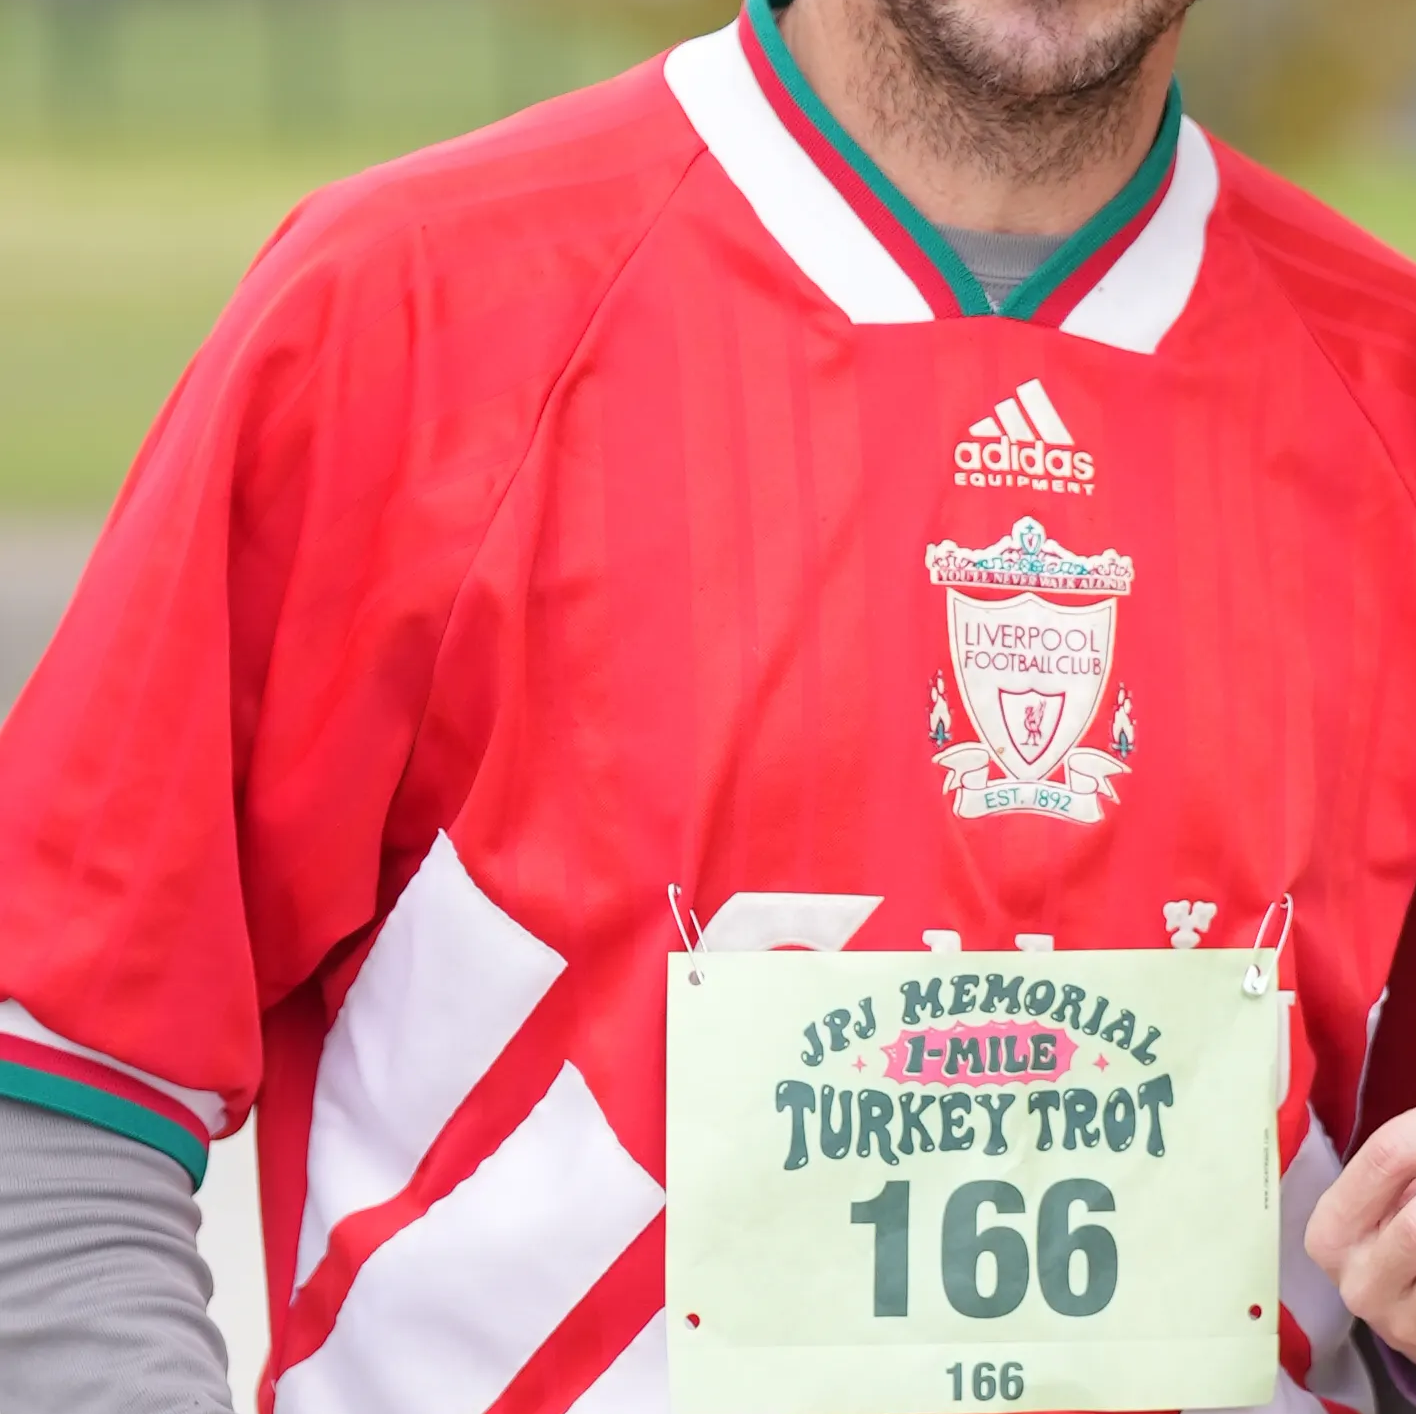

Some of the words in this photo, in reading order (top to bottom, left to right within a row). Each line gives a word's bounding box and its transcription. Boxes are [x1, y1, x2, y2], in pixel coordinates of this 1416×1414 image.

[954, 435, 1095, 481] adidas
[954, 472, 1096, 496] EQUIPMENT
[964, 622, 1101, 653] LIVERPOOL
[964, 651, 1054, 675] FOOTBALL
[1057, 653, 1102, 676] CLUB
[984, 789, 1025, 810] EST.
[1033, 786, 1073, 813] 1892
[800, 997, 875, 1067] JPJ
[900, 973, 1158, 1067] MEMORIAL
[903, 1033, 1058, 1076] 1-MILE
[775, 1079, 1015, 1171] TURKEY
[1027, 1073, 1174, 1158] TROT
[850, 1177, 1119, 1319] 166
[945, 1361, 1025, 1402] 166
